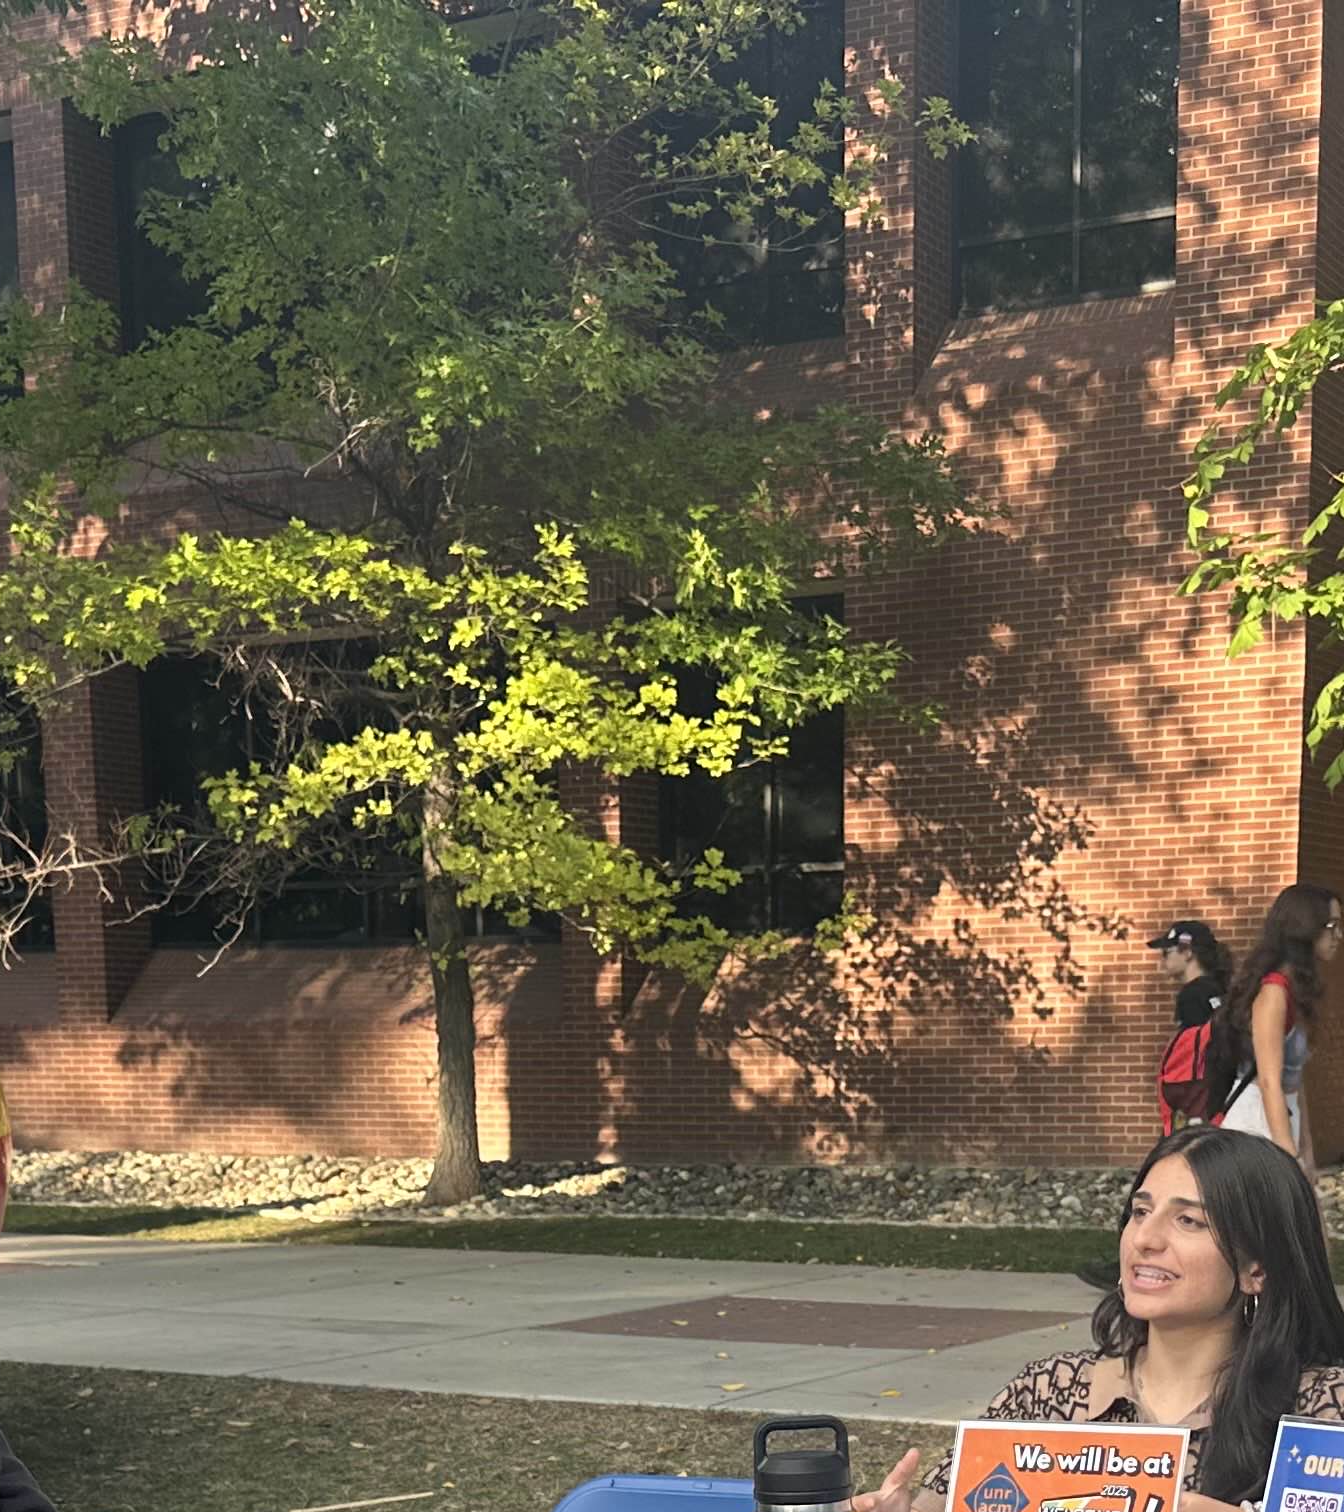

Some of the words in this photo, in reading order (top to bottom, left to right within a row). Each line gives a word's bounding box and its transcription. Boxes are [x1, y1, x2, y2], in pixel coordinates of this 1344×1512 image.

[1013, 1443, 1052, 1472] We
[1058, 1446, 1103, 1474] will
[1106, 1448, 1138, 1475] be
[1143, 1452, 1174, 1477] at
[1304, 1454, 1344, 1478] OUR
[983, 1487, 1013, 1500] unr
[1100, 1484, 1129, 1496] 2025
